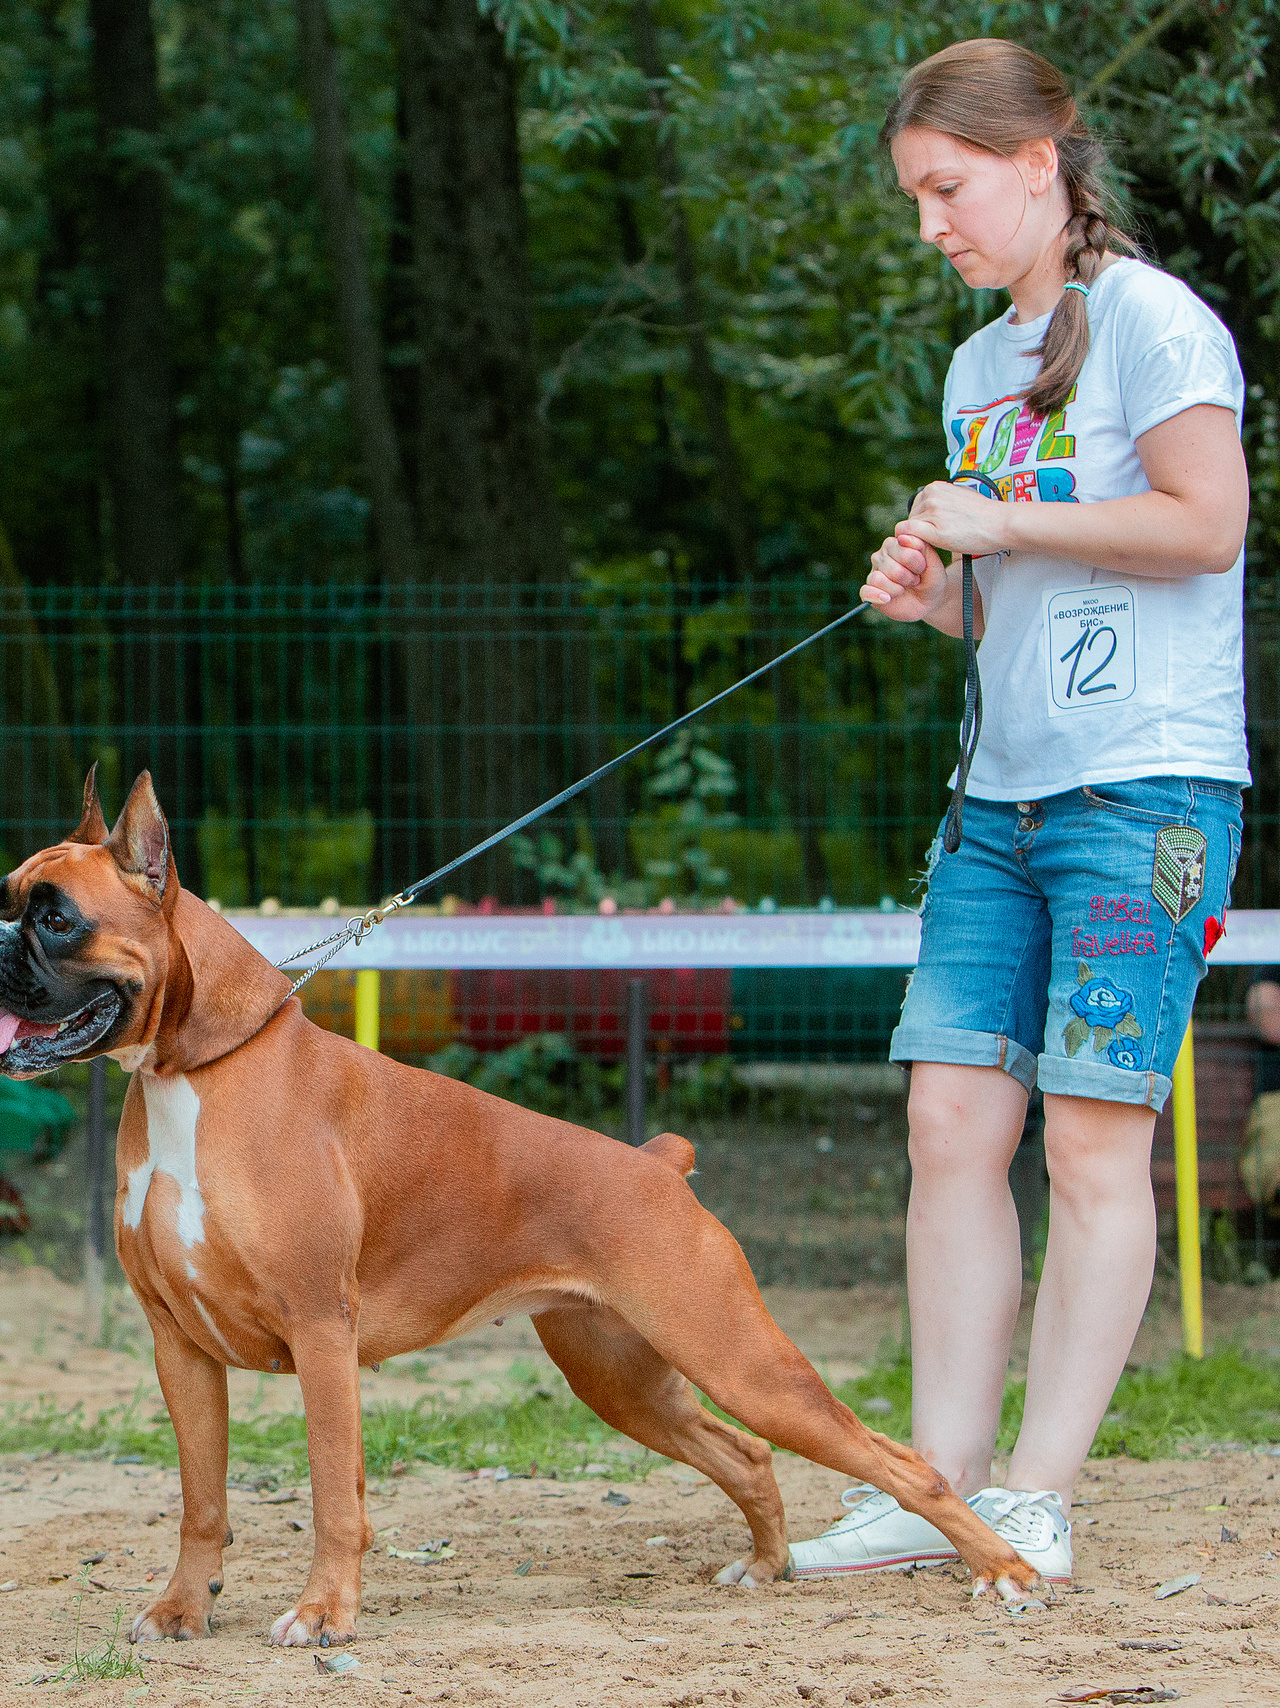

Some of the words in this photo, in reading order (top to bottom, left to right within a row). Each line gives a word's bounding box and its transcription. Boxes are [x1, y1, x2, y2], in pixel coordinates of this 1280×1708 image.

[1053, 602, 1130, 620] «ВОЗРОЖДЕНИЕ
[1079, 617, 1104, 629] БИС»
[1059, 626, 1118, 699] 12
